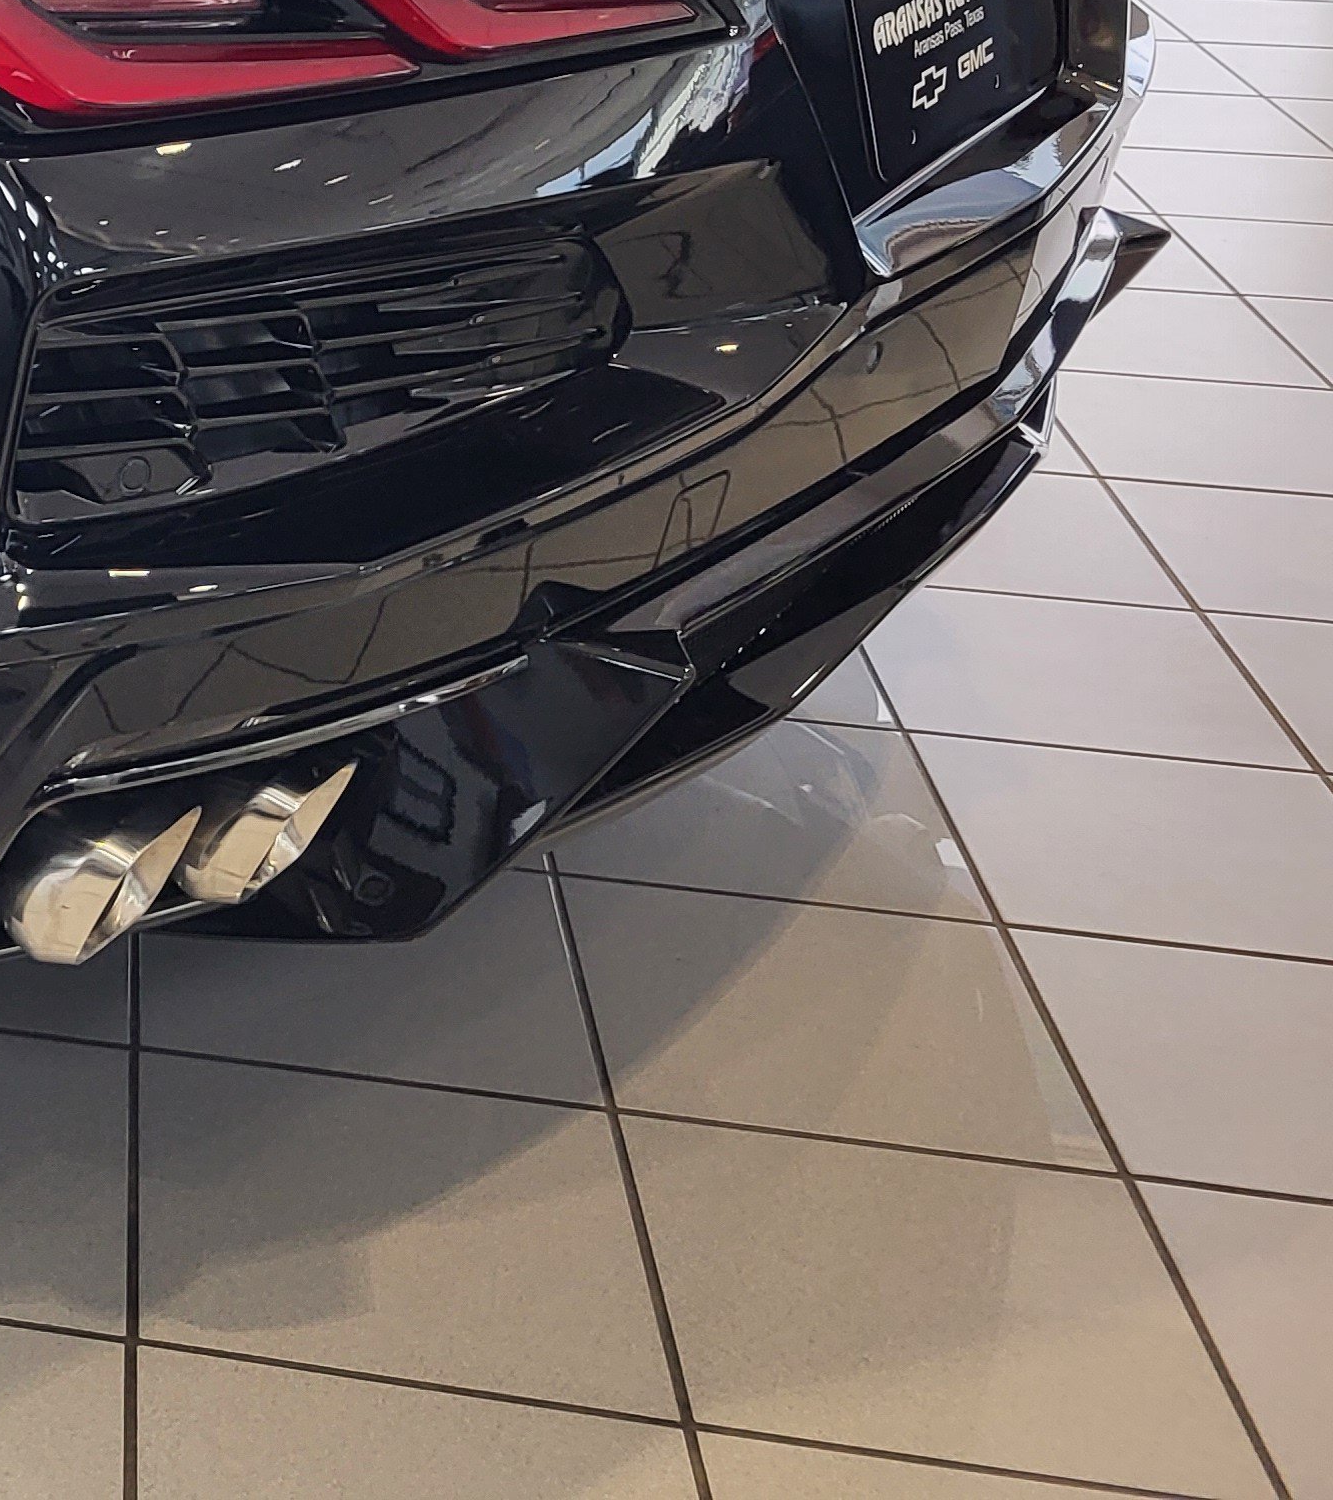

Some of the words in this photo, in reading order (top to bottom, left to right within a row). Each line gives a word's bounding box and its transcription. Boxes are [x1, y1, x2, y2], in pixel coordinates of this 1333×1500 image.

[913, 29, 944, 59] Aransas
[963, 6, 985, 29] Texas
[956, 37, 995, 80] GMC
